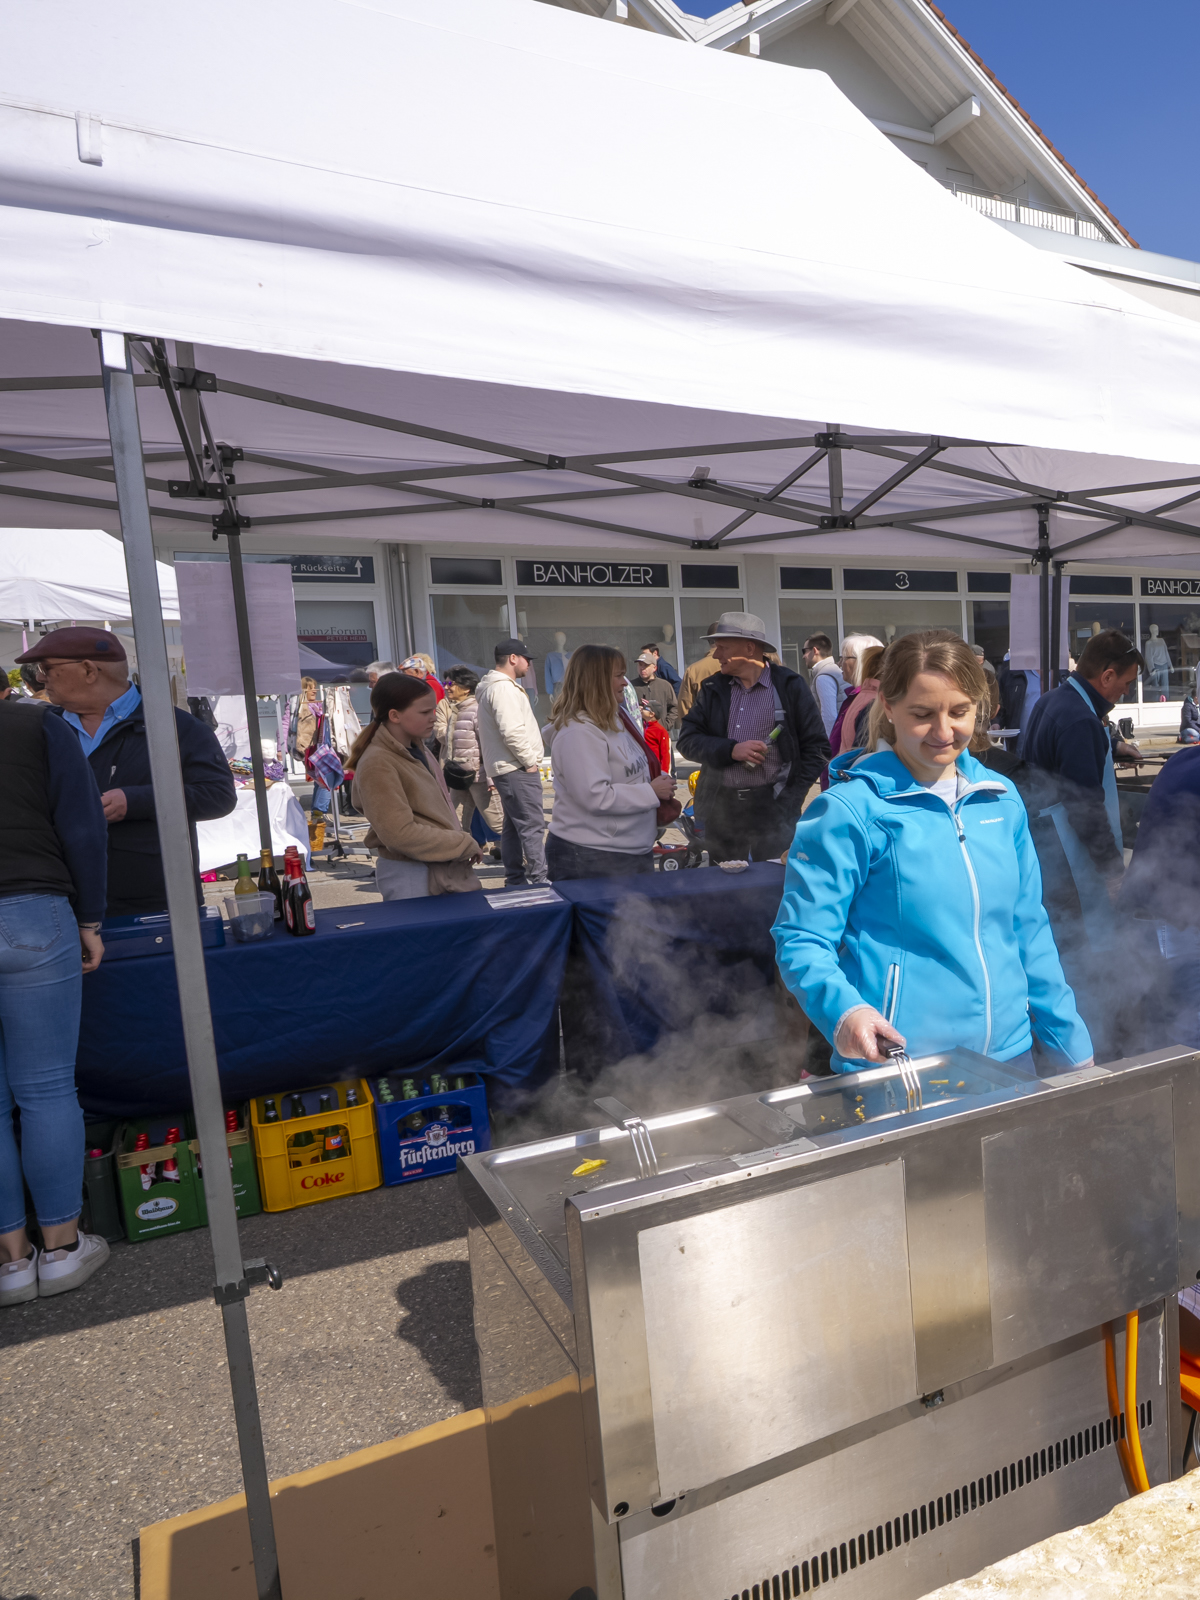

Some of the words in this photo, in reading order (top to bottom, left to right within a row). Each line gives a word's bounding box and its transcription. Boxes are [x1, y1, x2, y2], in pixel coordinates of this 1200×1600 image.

[300, 563, 347, 572] Rückseite
[533, 564, 653, 584] BANHOLZER
[297, 626, 367, 635] inanzForum
[301, 1172, 345, 1190] Coke
